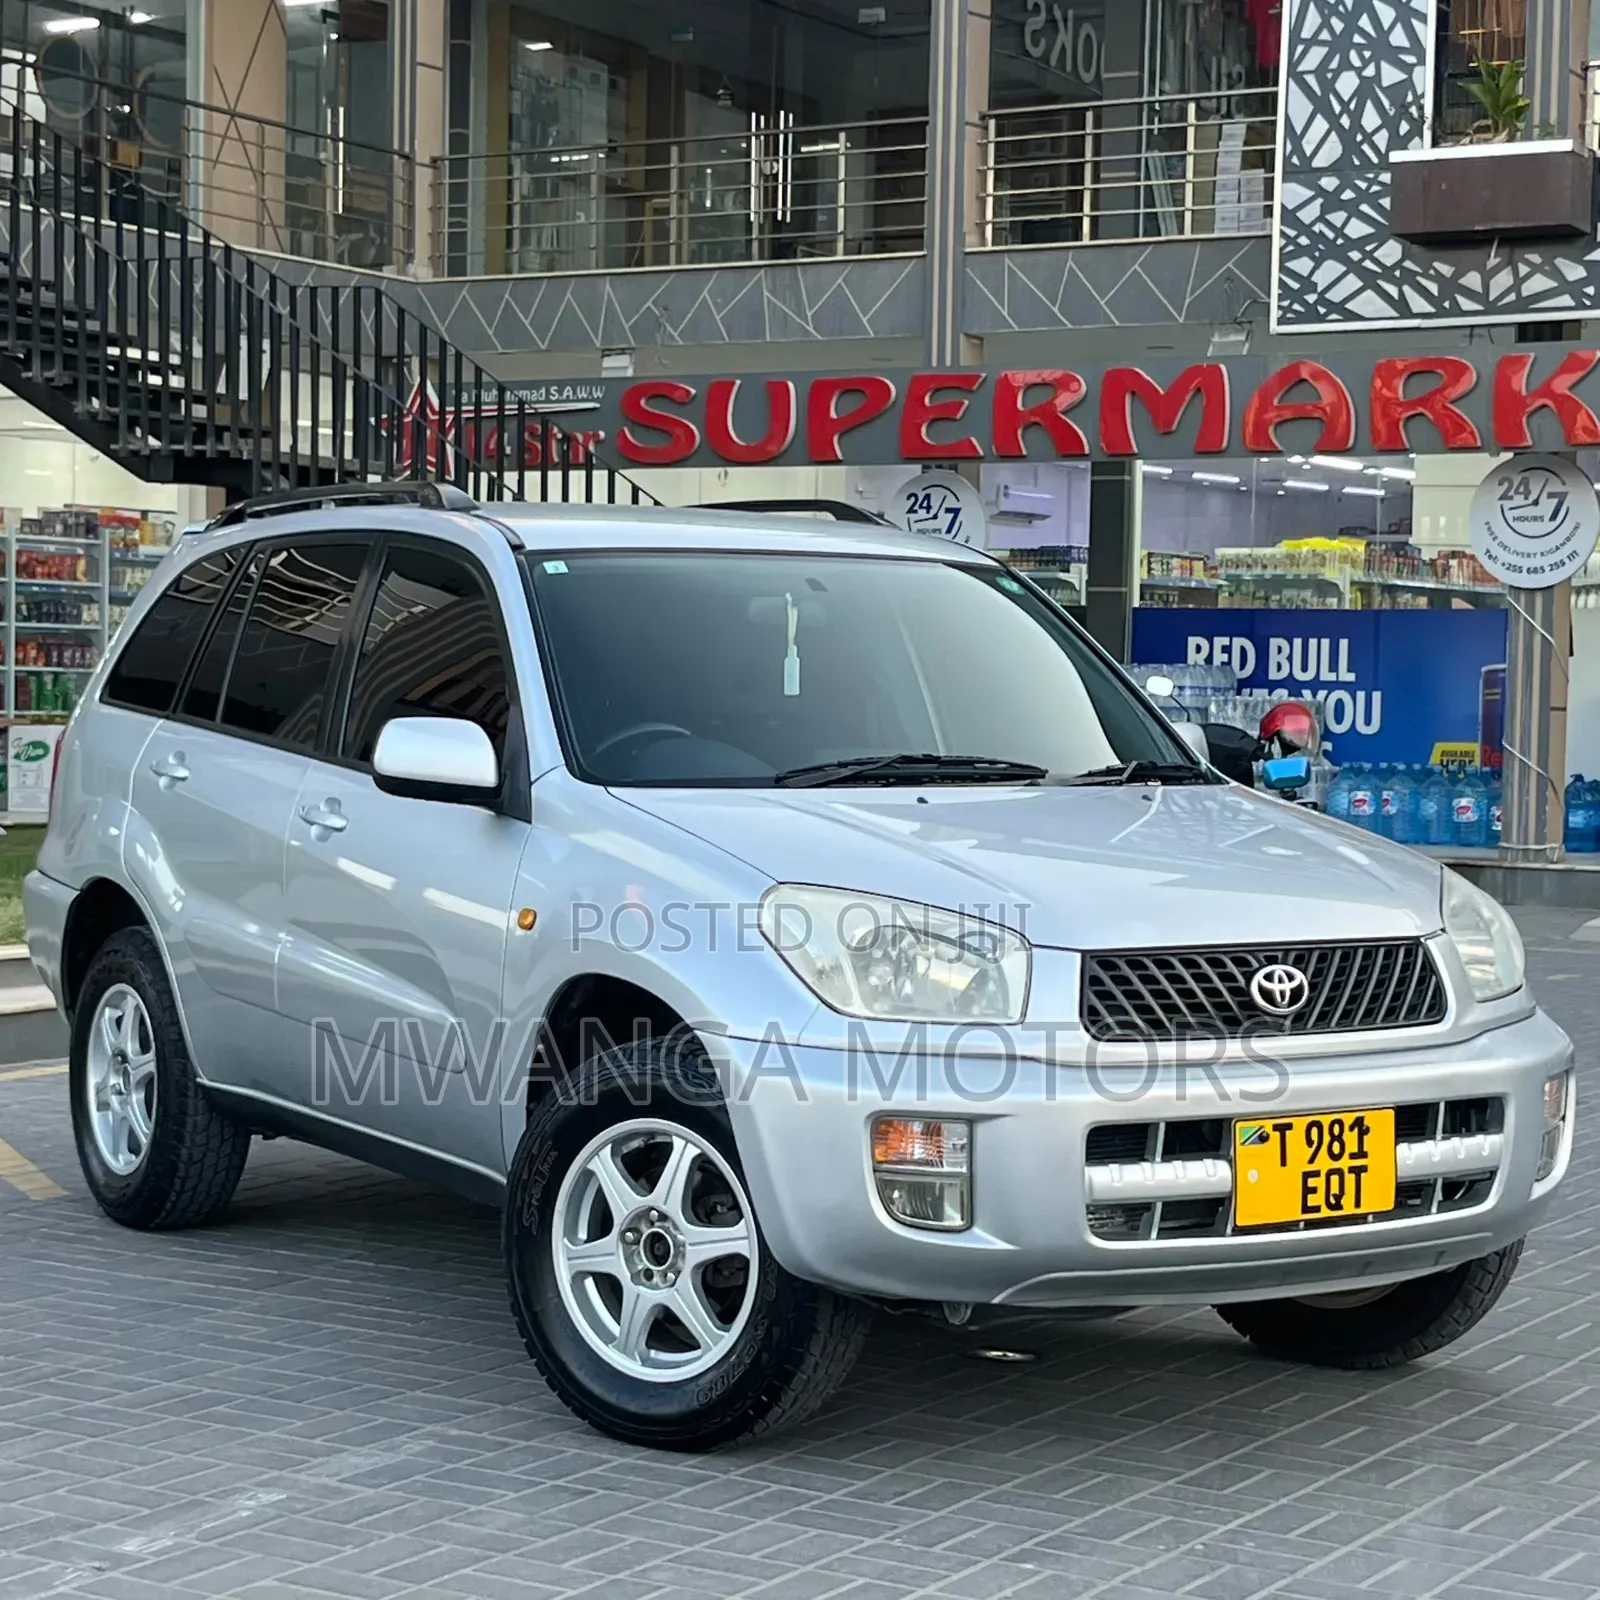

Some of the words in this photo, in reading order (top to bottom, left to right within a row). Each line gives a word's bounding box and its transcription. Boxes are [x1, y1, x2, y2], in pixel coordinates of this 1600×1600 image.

[472, 387, 546, 402] Muhmmad
[615, 350, 1600, 464] SUPERMARK
[1512, 515, 1545, 523] HOURS
[1501, 561, 1524, 575] +255
[1268, 637, 1357, 683] BULL
[1302, 689, 1382, 735] OU
[1272, 1122, 1293, 1167] T
[1304, 1115, 1370, 1165] 981
[1300, 1164, 1368, 1215] EQT
